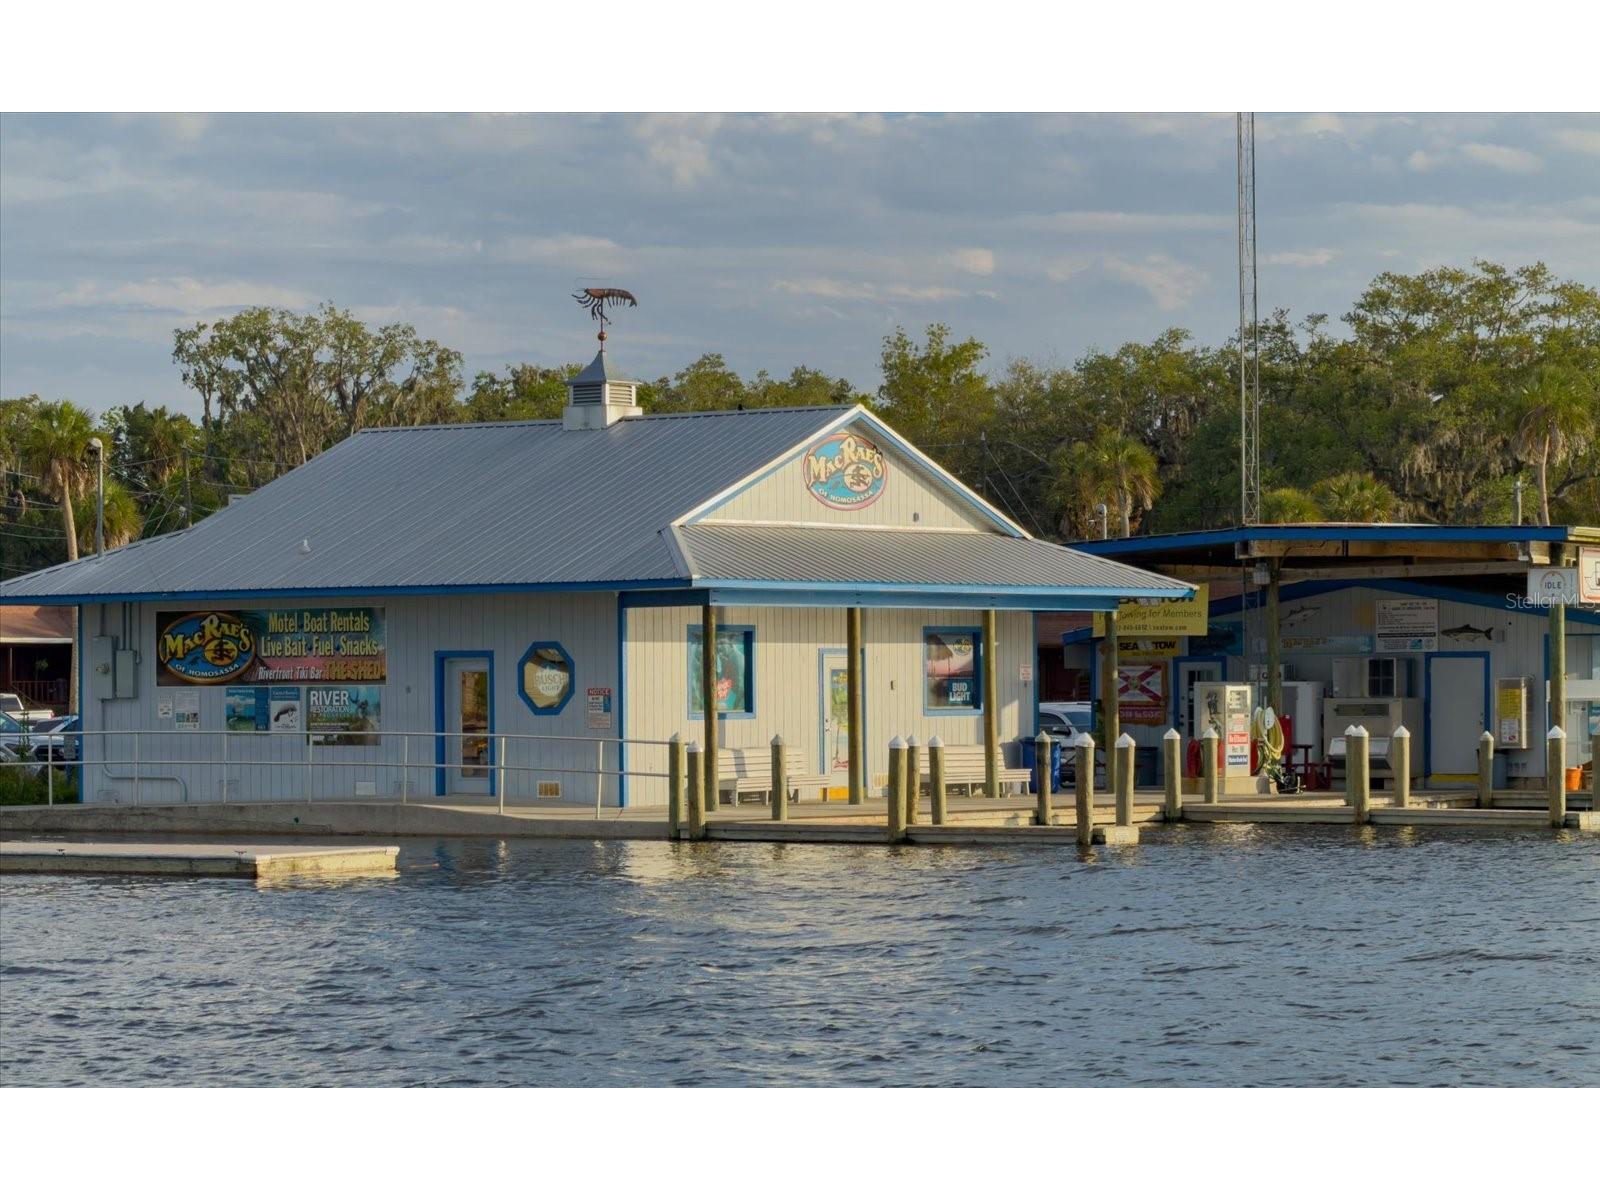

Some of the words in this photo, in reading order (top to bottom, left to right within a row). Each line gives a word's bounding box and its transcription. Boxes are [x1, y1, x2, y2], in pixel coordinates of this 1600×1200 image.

[831, 490, 873, 503] HOMOSASSA
[1544, 581, 1562, 589] IDLE
[1149, 609, 1160, 618] for
[1163, 609, 1202, 618] Members
[268, 612, 299, 632] Motel
[303, 612, 328, 632] Boat
[330, 611, 370, 632] Rentals
[261, 637, 282, 656] Live
[284, 636, 307, 656] Bait
[312, 636, 335, 656] Fuel
[340, 635, 379, 656] Snacks
[1119, 642, 1139, 650] SEA
[1154, 641, 1176, 649] TOW
[175, 664, 185, 672] OF
[189, 663, 239, 677] HOMOSASSA
[259, 667, 294, 679] Riverfront
[295, 666, 309, 679] Tiki
[310, 667, 323, 679] Bar
[952, 682, 968, 692] BUD
[310, 690, 349, 706] RIVER
[948, 692, 971, 702] LIGHT
[310, 705, 350, 713] RESTORATION
